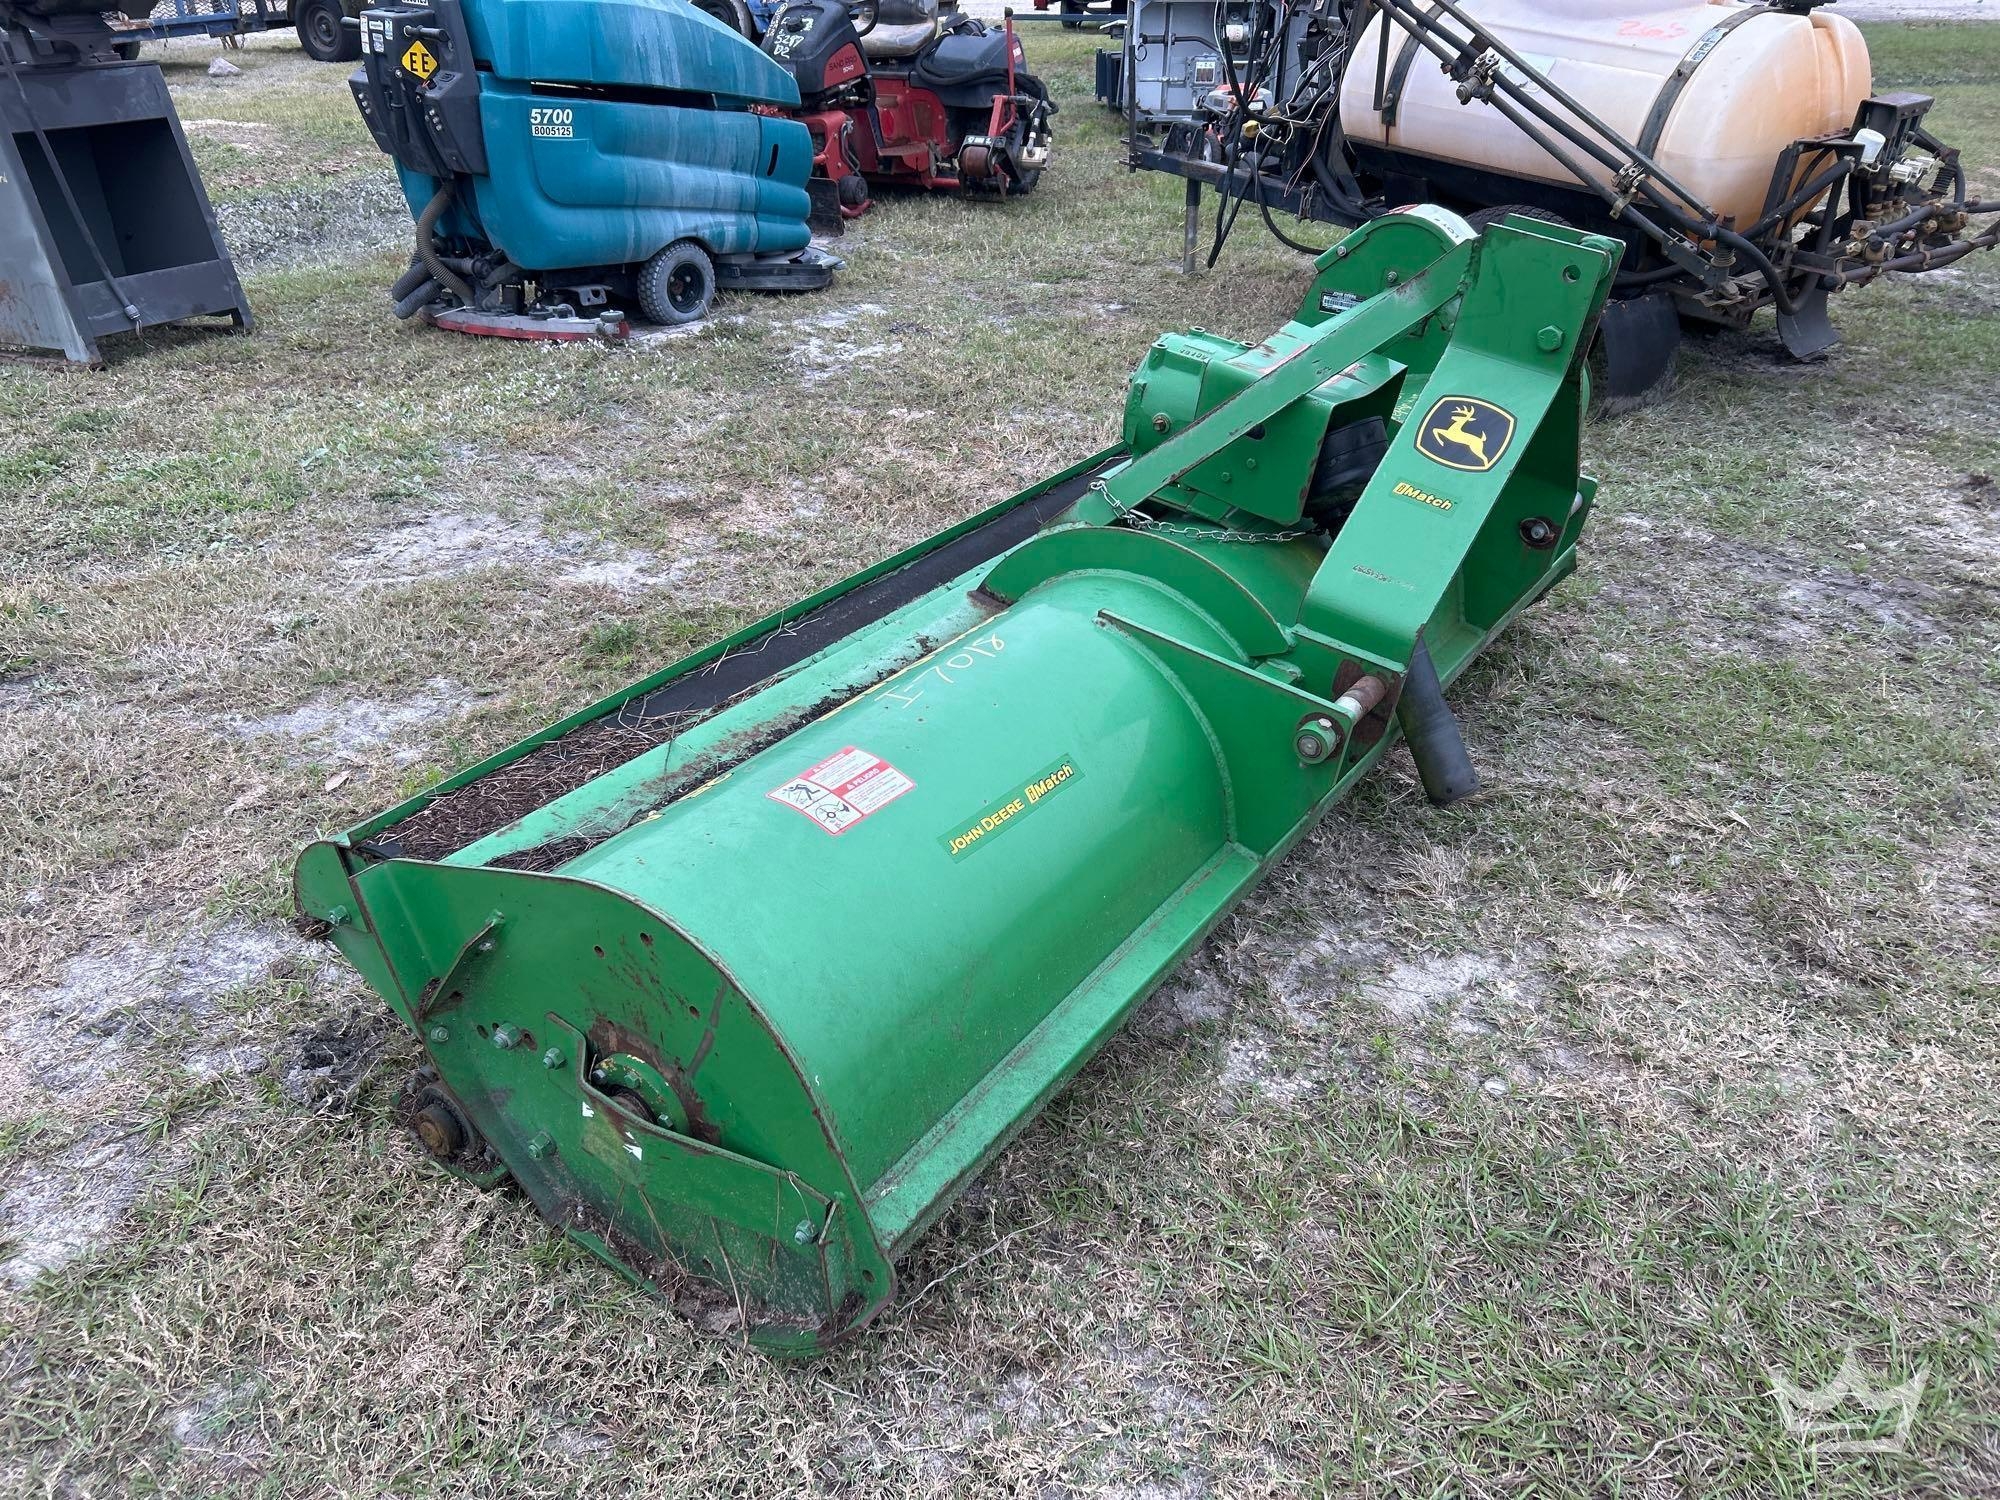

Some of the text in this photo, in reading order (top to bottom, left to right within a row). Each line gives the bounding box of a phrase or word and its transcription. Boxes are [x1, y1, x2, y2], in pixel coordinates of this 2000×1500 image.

[530, 108, 573, 124] 5700
[534, 126, 571, 136] 8005125
[1392, 482, 1453, 511] iMatch
[948, 763, 1075, 855] JOHN DEERE iMatch
